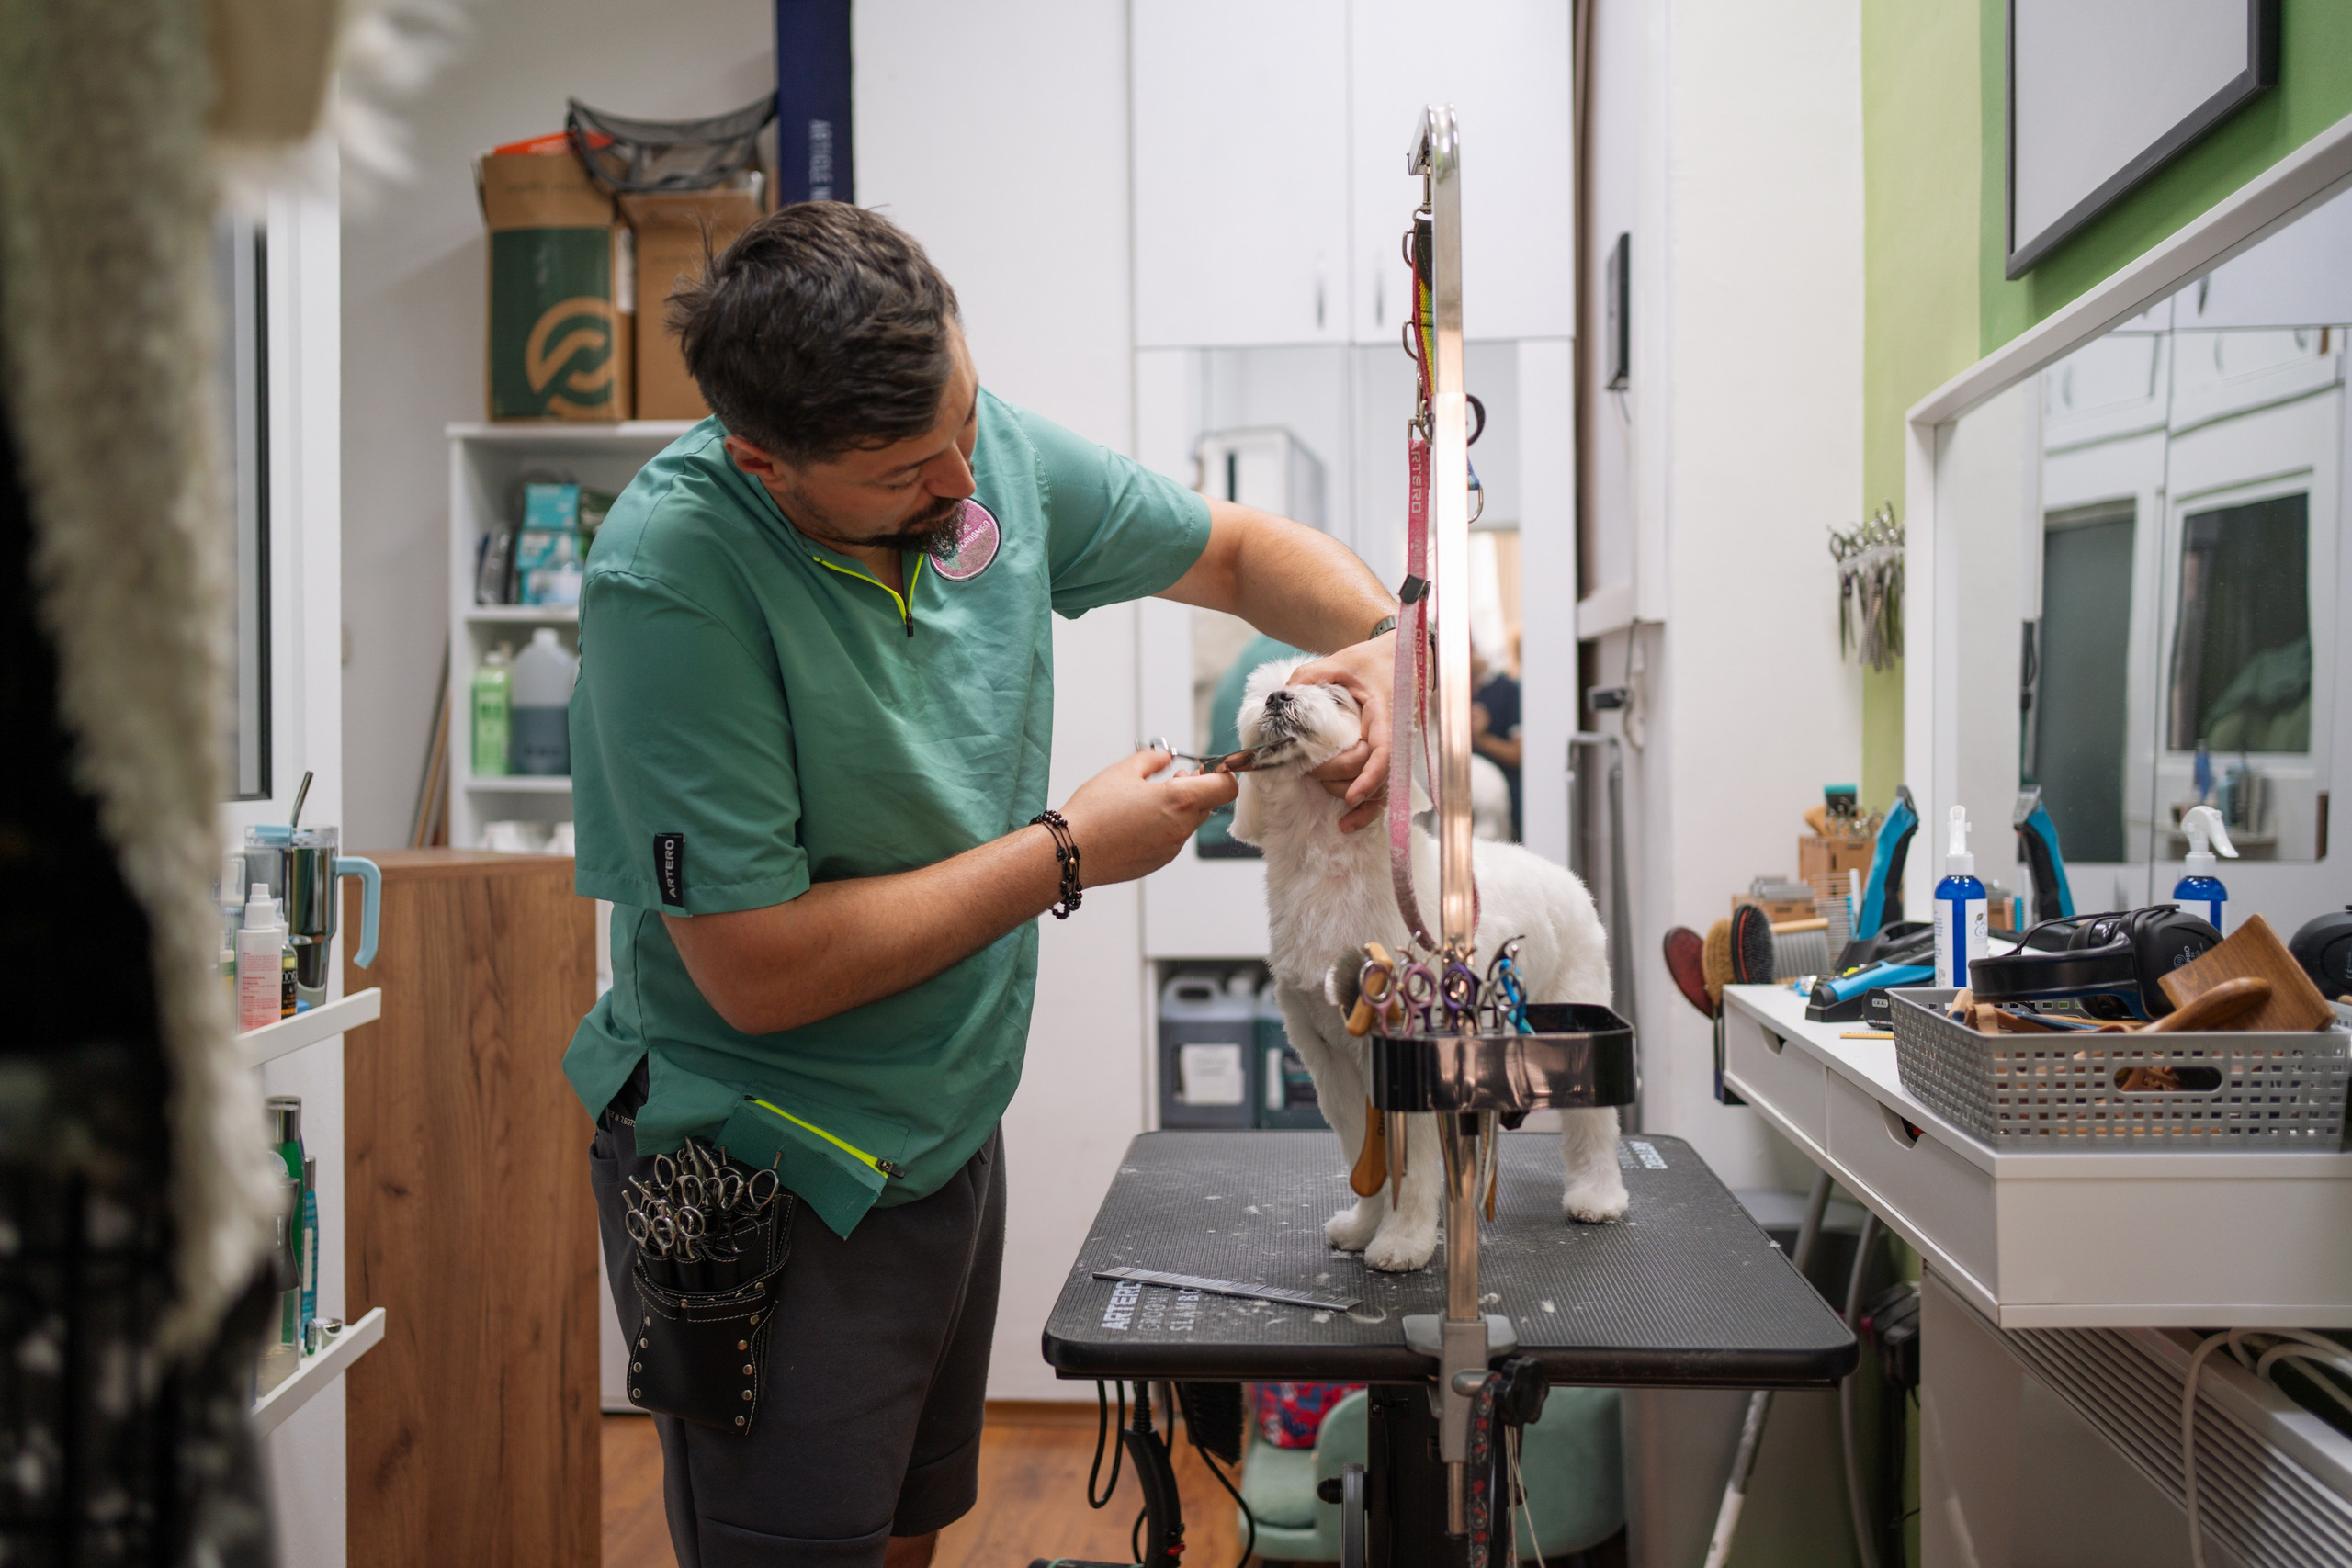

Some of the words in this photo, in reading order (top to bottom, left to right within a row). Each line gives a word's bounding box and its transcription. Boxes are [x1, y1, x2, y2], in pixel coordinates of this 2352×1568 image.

[1410, 440, 1422, 513] ARTERO
[664, 840, 676, 898] ARTERO
[1101, 1280, 1142, 1331] ARTERO
